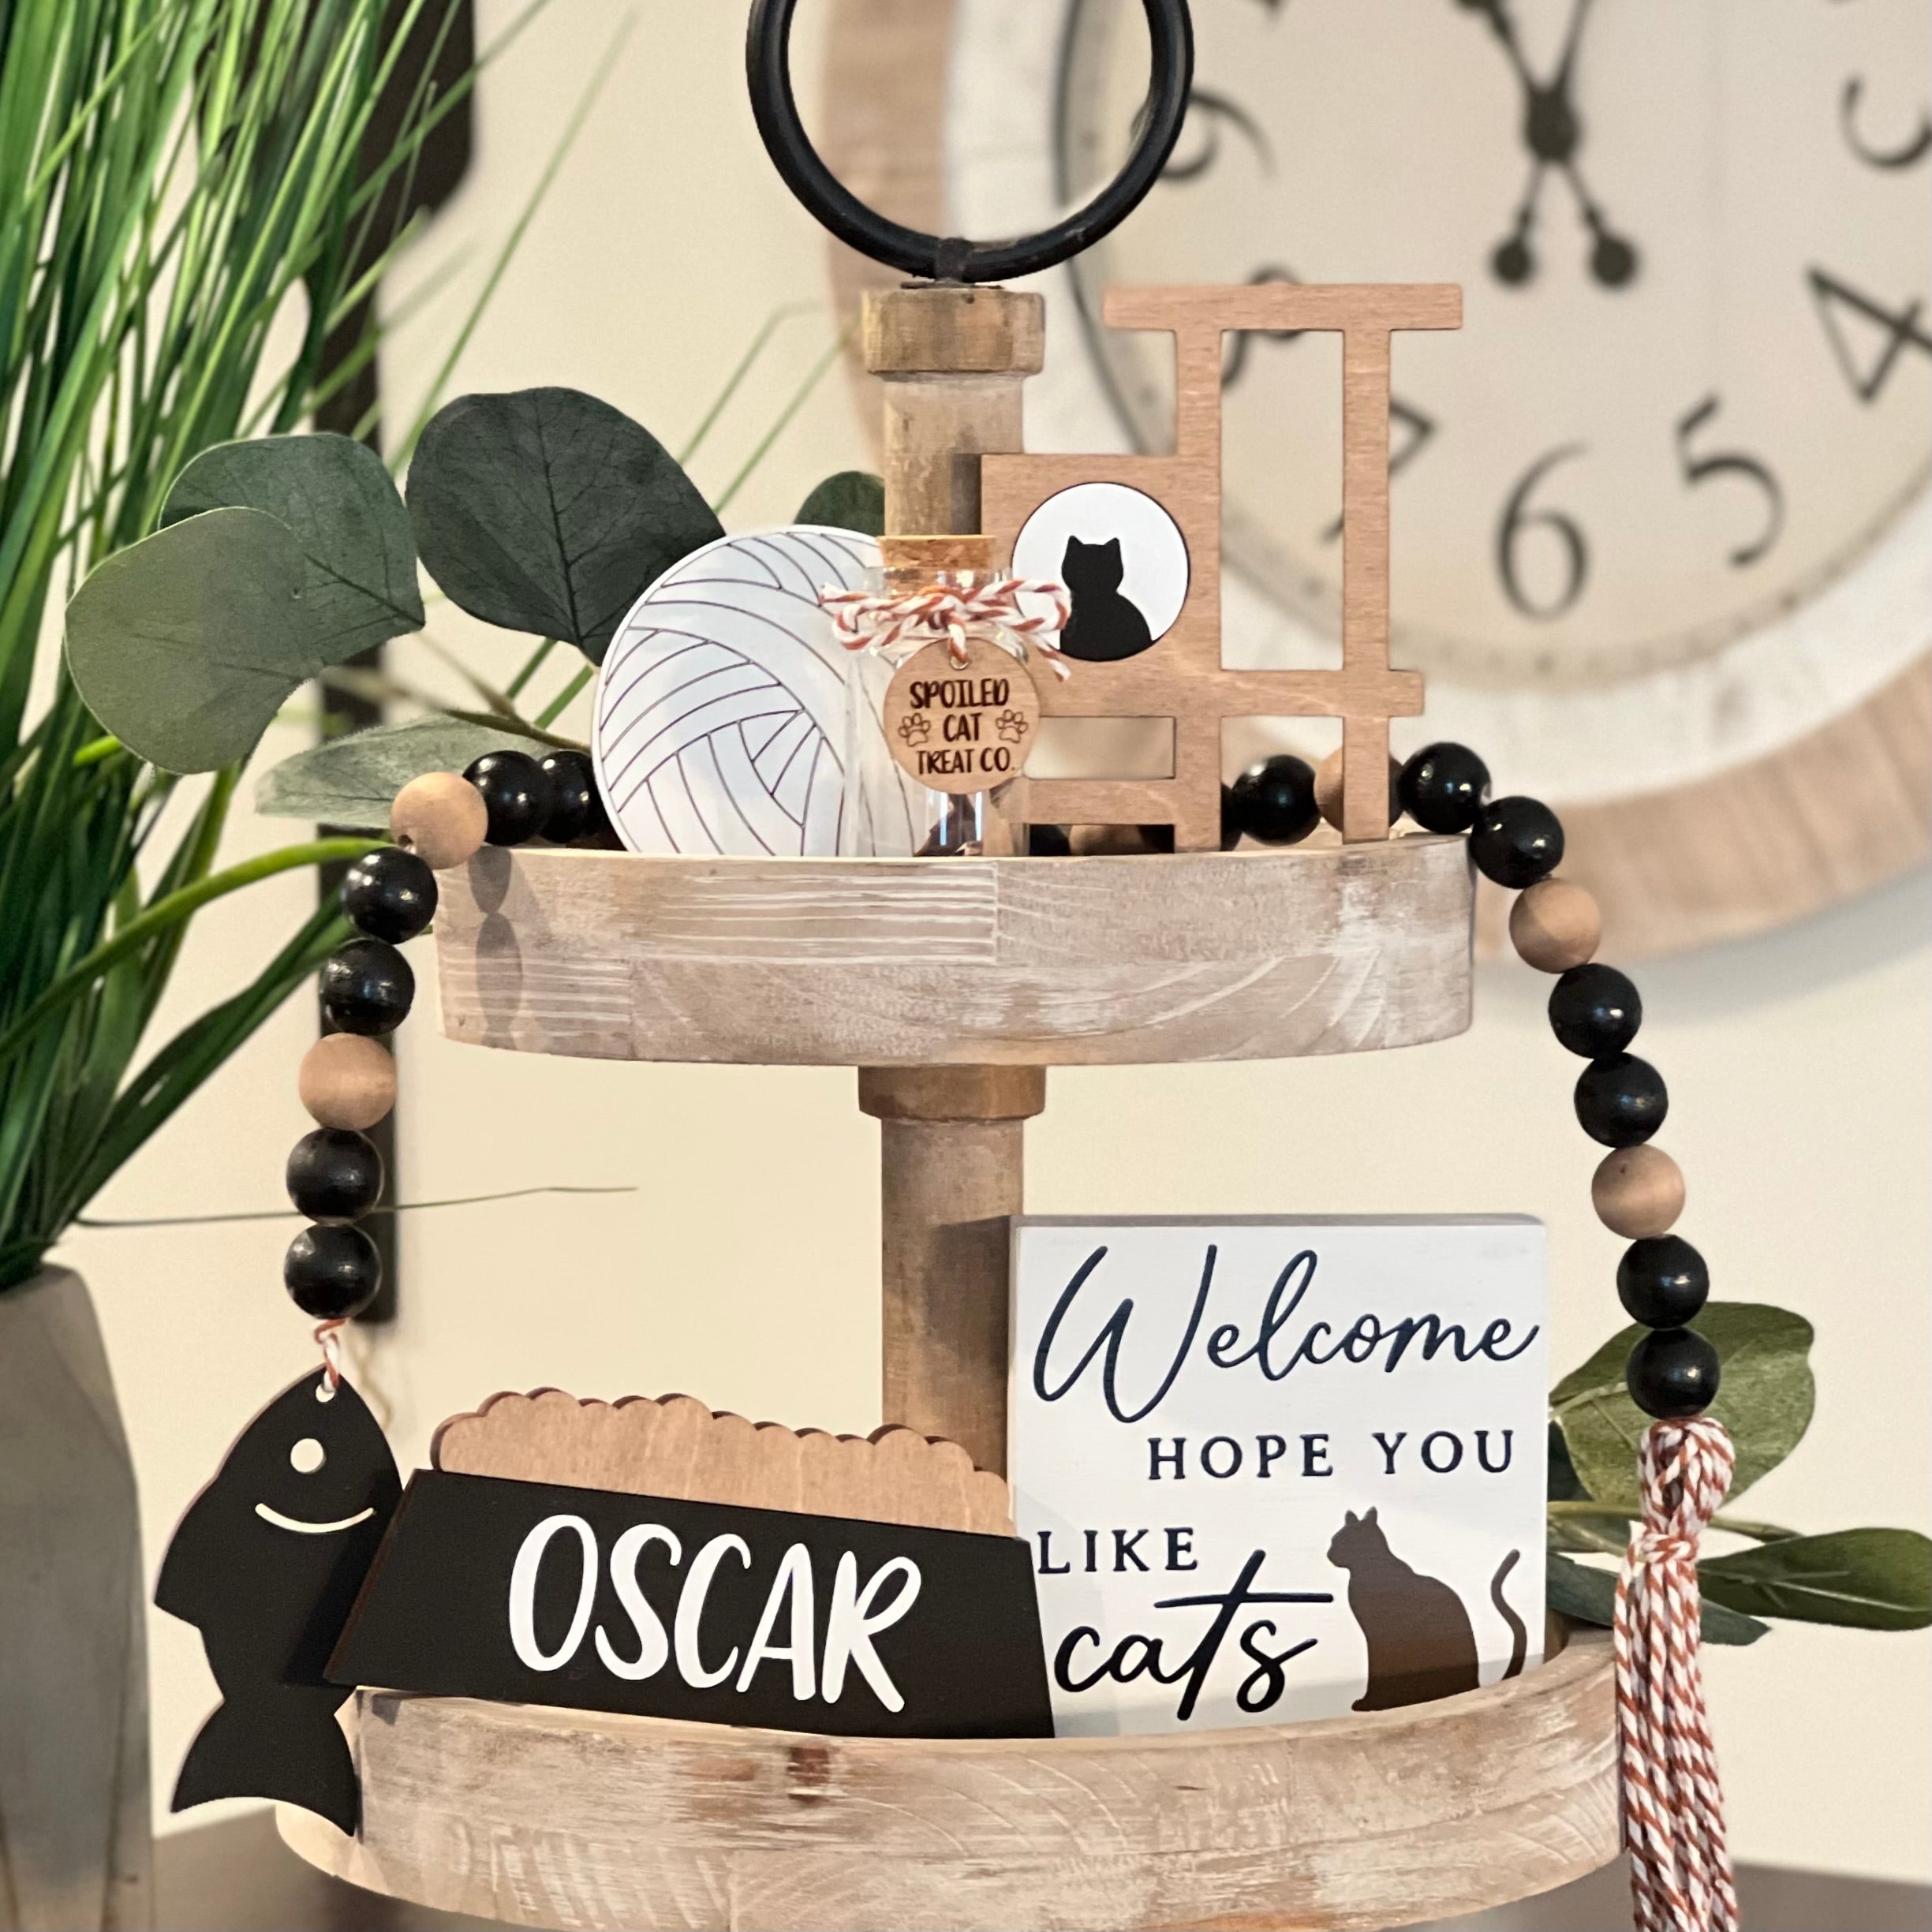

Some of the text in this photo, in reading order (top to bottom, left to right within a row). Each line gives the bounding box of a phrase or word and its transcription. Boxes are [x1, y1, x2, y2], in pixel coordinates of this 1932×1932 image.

[1494, 440, 1592, 623] 6
[1676, 392, 1786, 571] 5
[910, 678, 1010, 708] SPOILED
[943, 712, 983, 742] CAT
[916, 746, 1015, 775] TREAT CO.
[1032, 1244, 1540, 1423] Welcome
[1147, 1429, 1514, 1480] HOPE YOU
[1036, 1527, 1198, 1574] LIKE
[509, 1514, 921, 1713] OSCAR
[1054, 1549, 1334, 1721] cats
